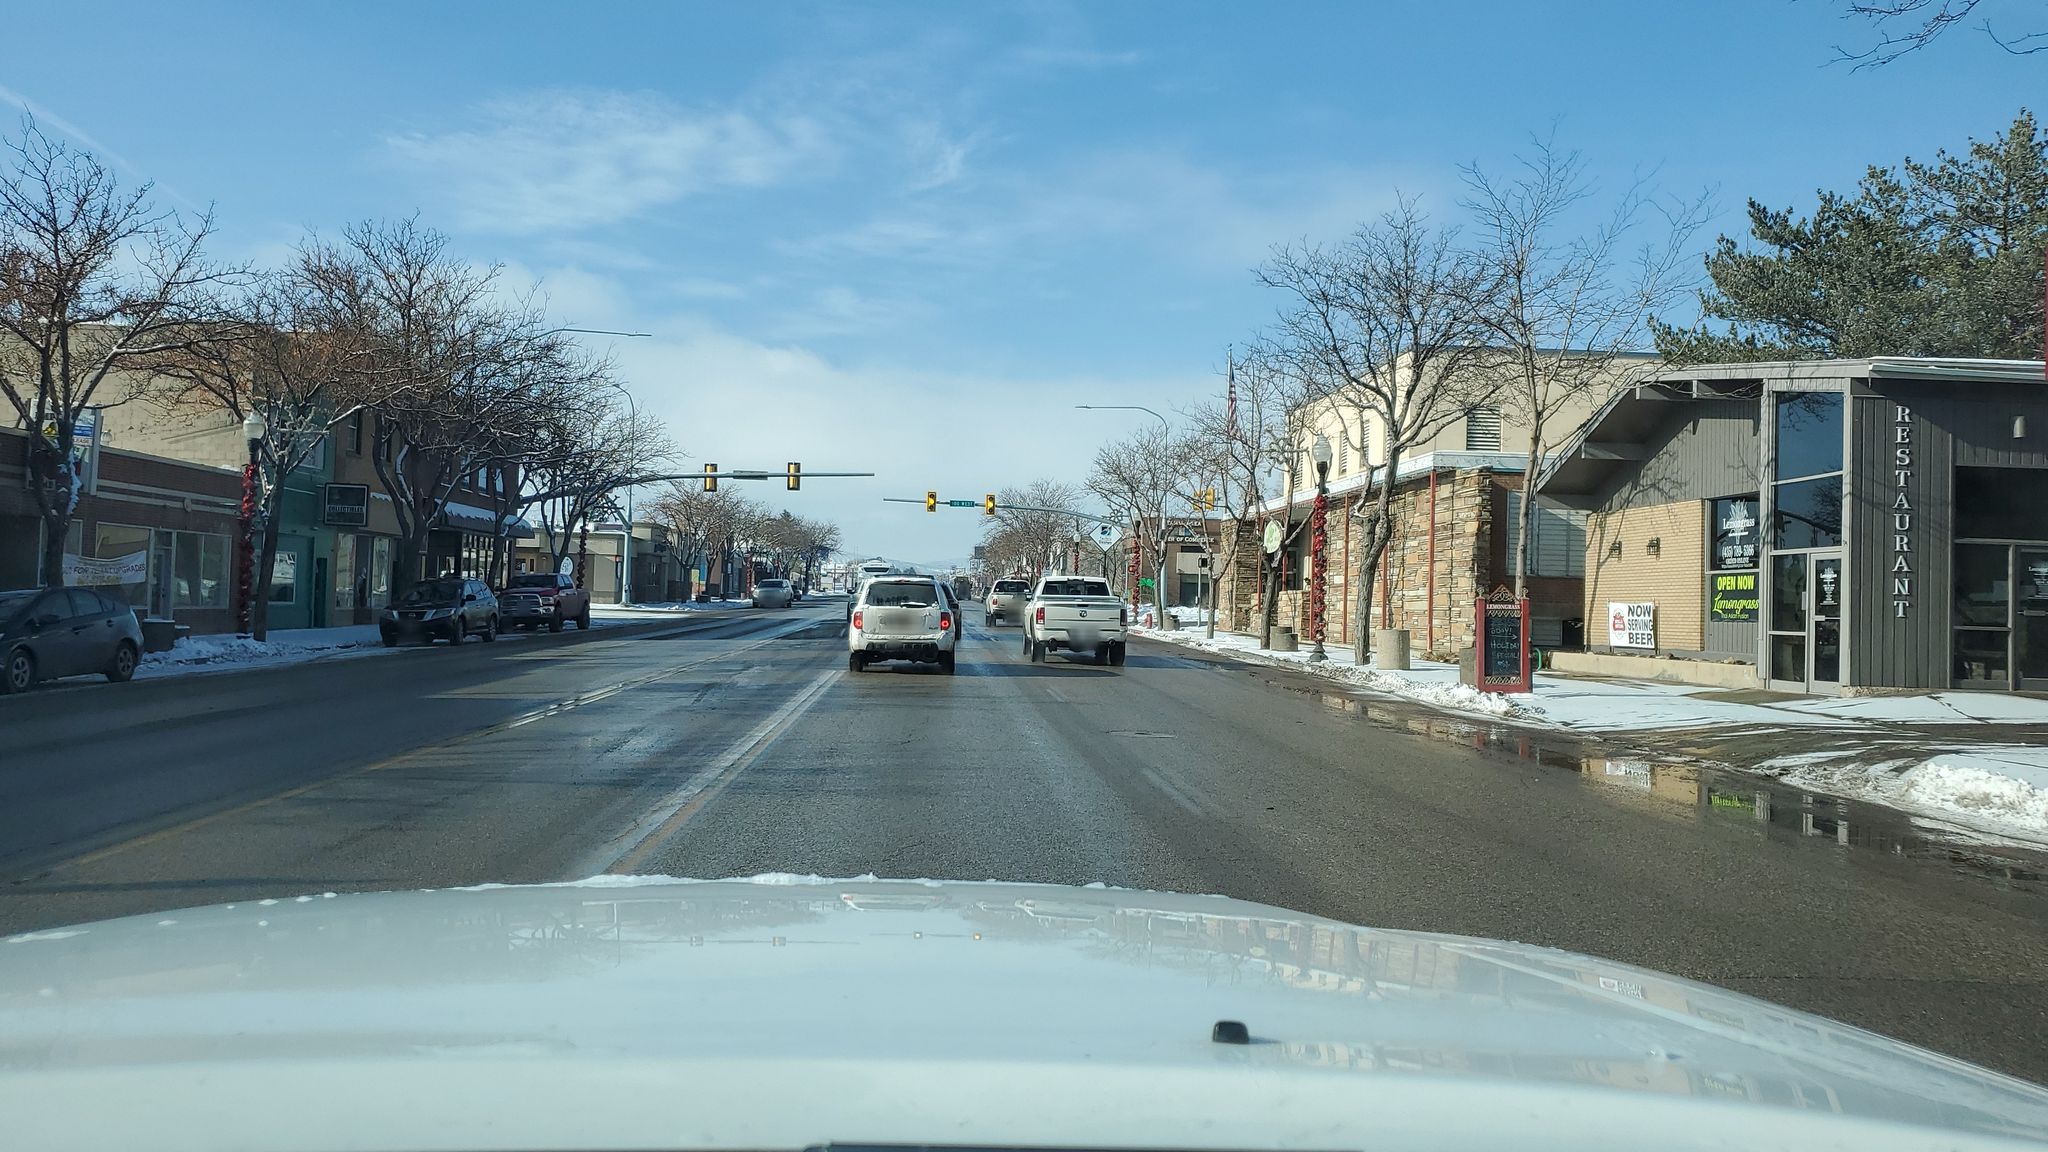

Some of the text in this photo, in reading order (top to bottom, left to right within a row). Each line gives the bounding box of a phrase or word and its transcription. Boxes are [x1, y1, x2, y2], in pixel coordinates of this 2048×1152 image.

[1892, 405, 1912, 618] RESTAURANT
[1722, 518, 1755, 530] Lemongrass
[1717, 575, 1755, 591] OPEN NOW
[1713, 592, 1759, 614] Lemongrass
[1627, 604, 1652, 617] NOW
[1627, 618, 1654, 632] SERVING
[1628, 632, 1653, 646] BEER
